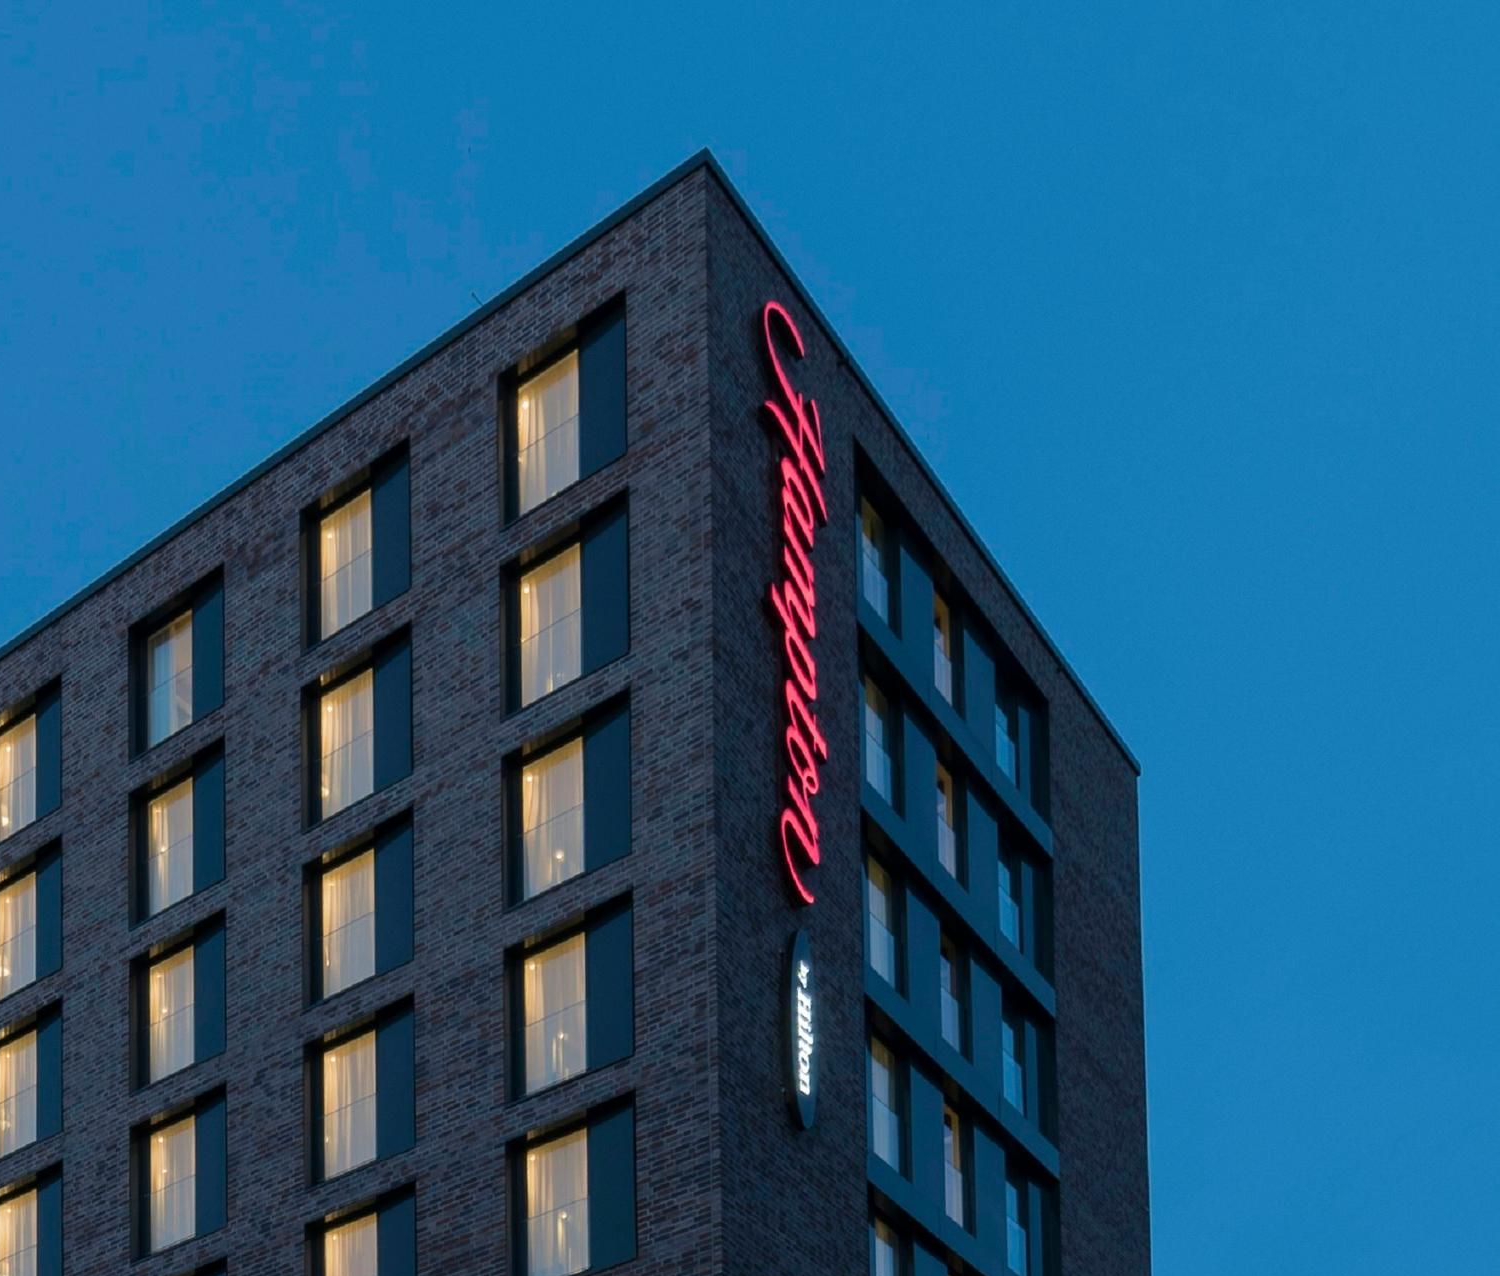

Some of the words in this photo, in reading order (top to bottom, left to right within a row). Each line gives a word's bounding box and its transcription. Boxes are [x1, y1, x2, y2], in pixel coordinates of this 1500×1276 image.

[764, 300, 828, 904] Hampton
[797, 960, 810, 988] by
[796, 988, 814, 1096] Hilton
